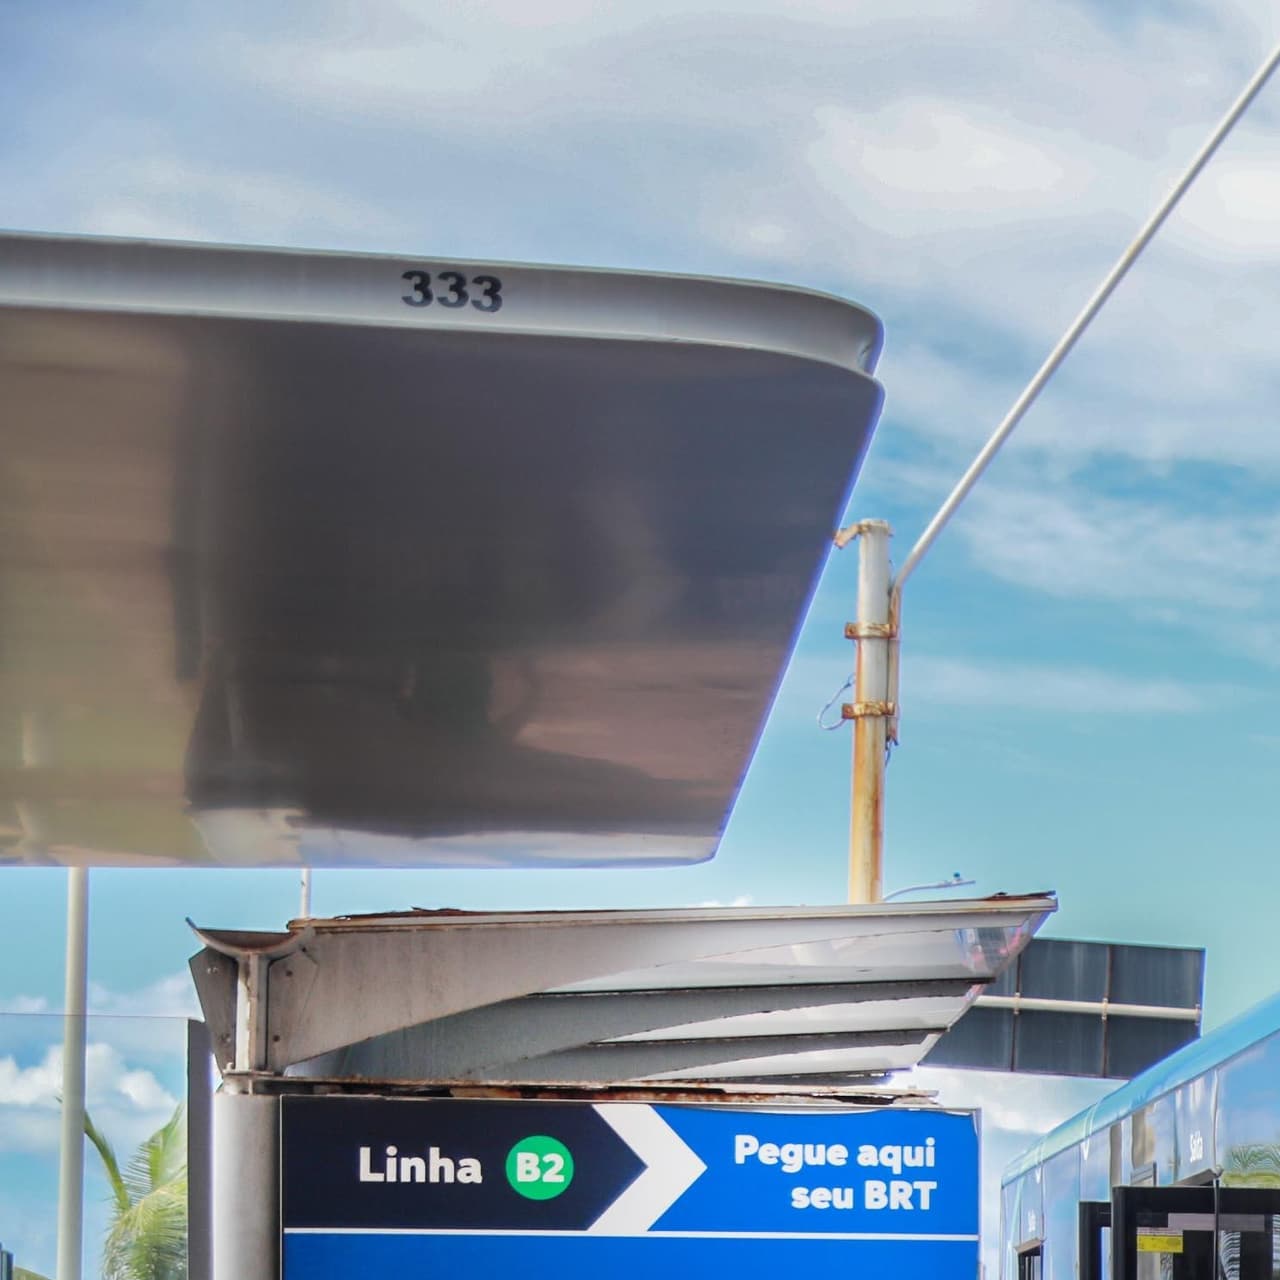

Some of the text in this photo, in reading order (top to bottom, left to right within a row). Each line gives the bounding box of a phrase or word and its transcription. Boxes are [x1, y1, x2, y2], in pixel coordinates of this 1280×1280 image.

[401, 270, 503, 313] 333
[358, 1145, 565, 1184] Linha B2
[734, 1134, 936, 1175] Pegue aqui
[791, 1179, 938, 1210] seu BRT
